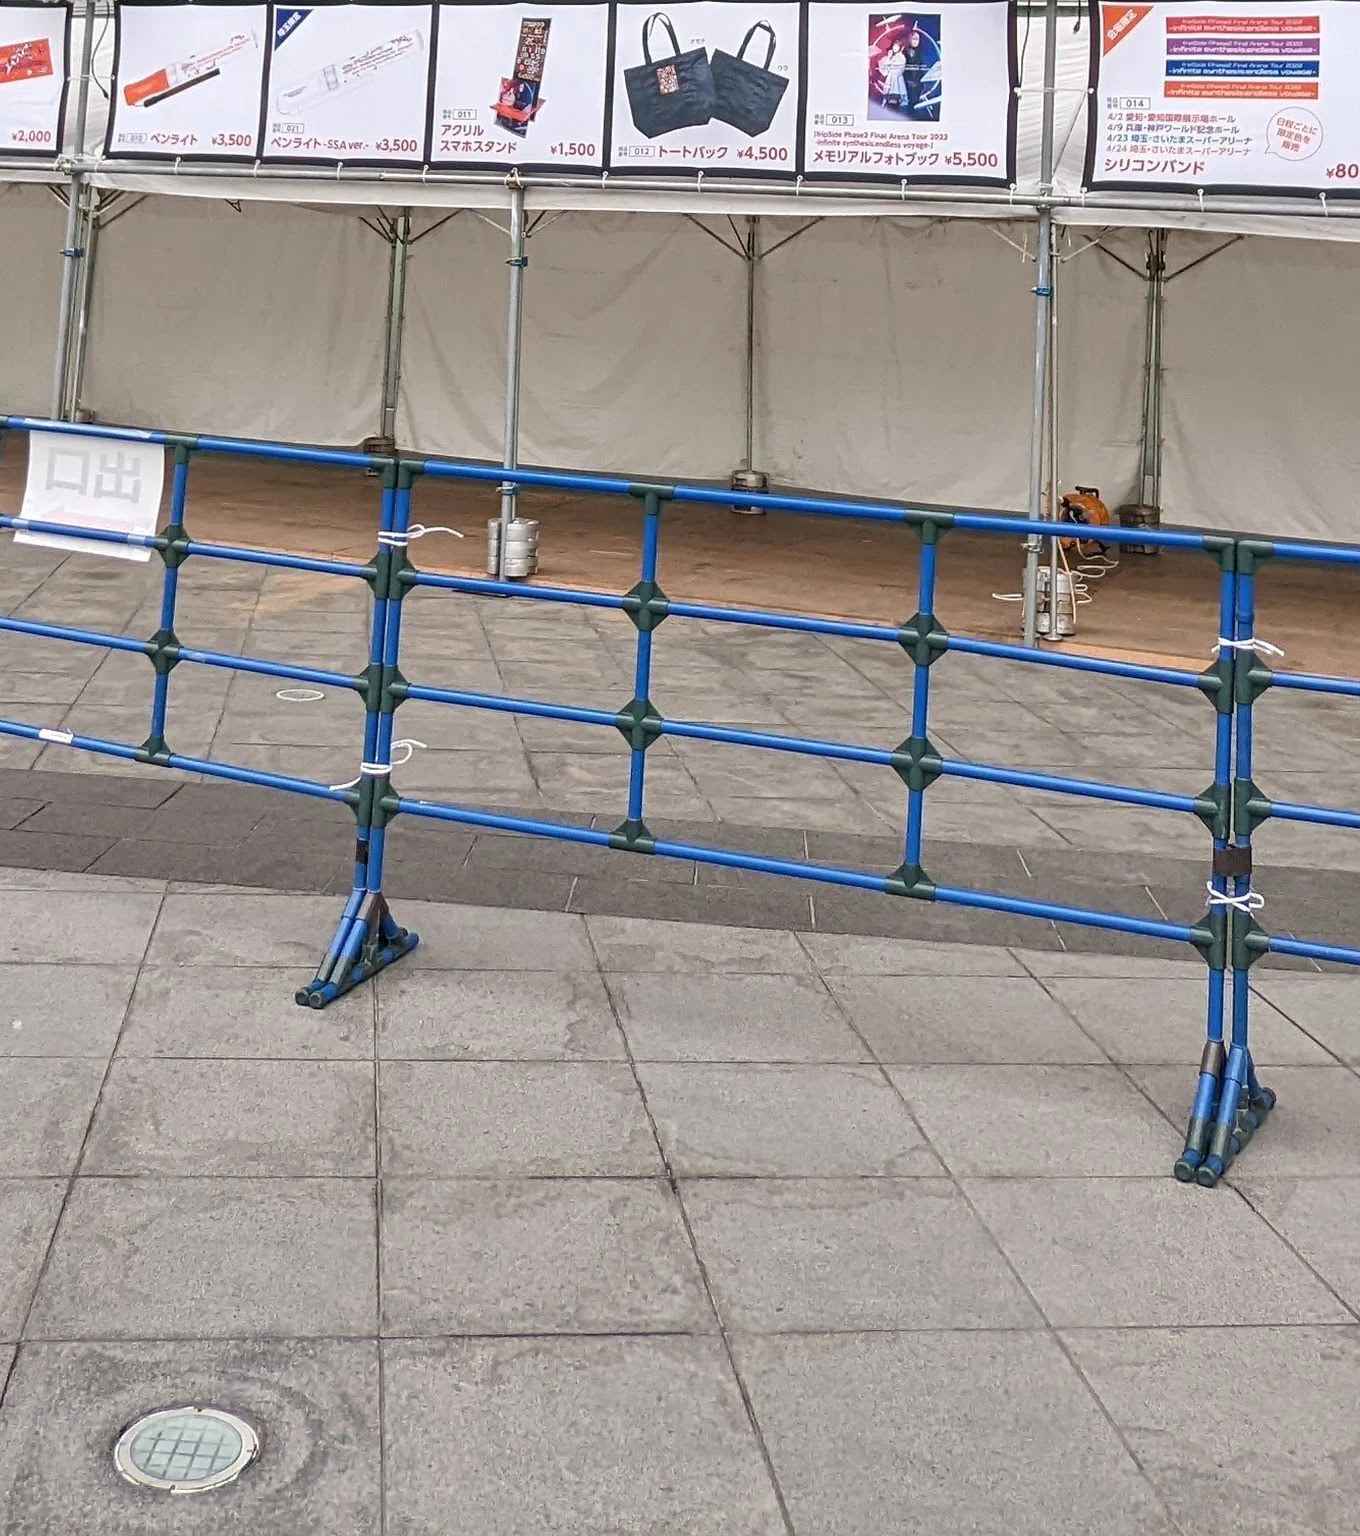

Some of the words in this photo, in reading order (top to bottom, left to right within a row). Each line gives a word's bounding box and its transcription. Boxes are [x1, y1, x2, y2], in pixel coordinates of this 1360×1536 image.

[1126, 99, 1144, 108] 014
[831, 116, 848, 125] 013
[12, 129, 52, 143] ¥2,000
[441, 124, 484, 137] アクリル
[150, 133, 198, 146] ペンライト
[212, 134, 252, 147] ¥3,500
[375, 138, 418, 153] ¥3,500
[440, 140, 517, 154] スマホスタンド
[550, 143, 596, 158] ¥1,500
[737, 146, 788, 162] ¥4,500
[813, 150, 939, 166] メモリアルフォトブック
[945, 152, 998, 168] ¥5,500
[1104, 158, 1205, 176] シリコンバンド
